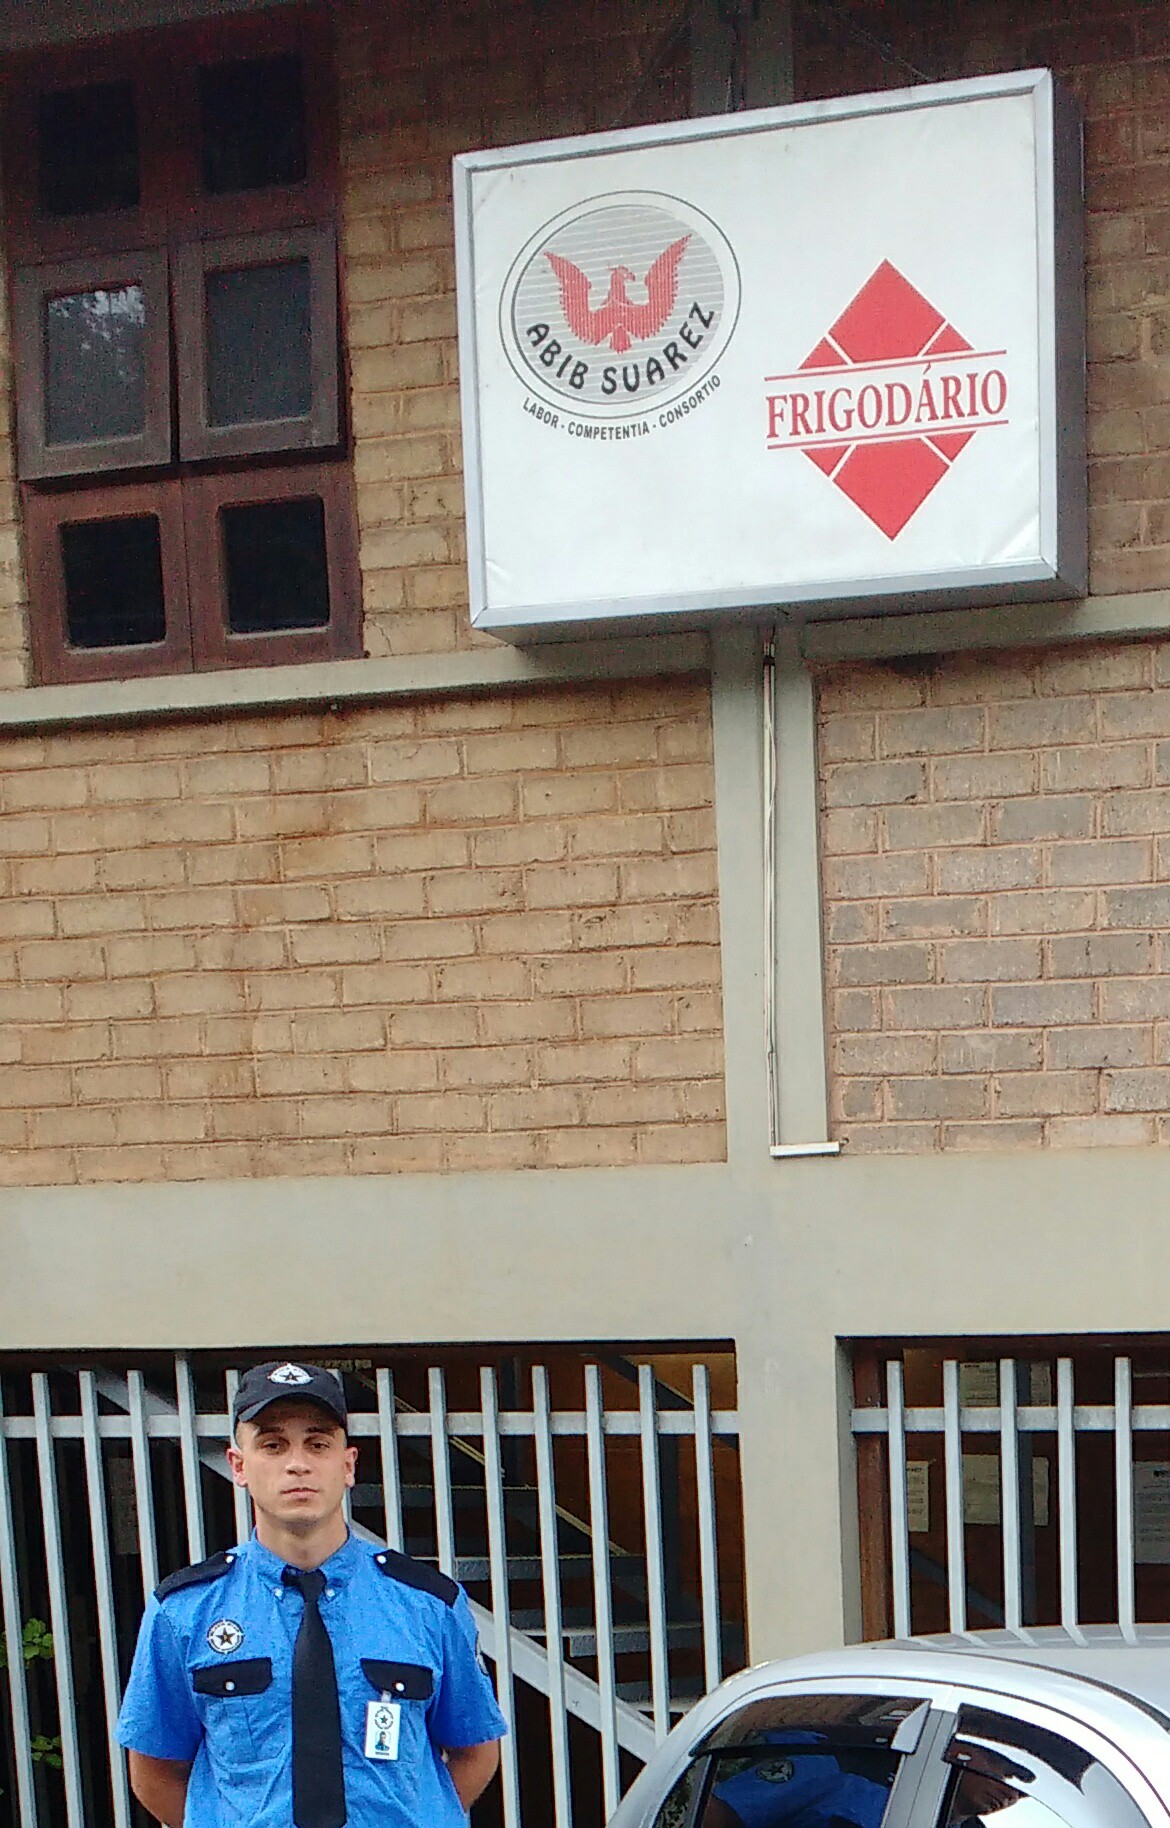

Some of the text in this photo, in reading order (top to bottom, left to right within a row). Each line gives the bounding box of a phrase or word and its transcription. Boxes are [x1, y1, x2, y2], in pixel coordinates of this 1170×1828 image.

[526, 301, 715, 395] ABIB SUAREZ
[522, 374, 721, 441] LABOR COMPETENTIA CONSORTIO
[765, 361, 1008, 439] FRIGODÁRIO
